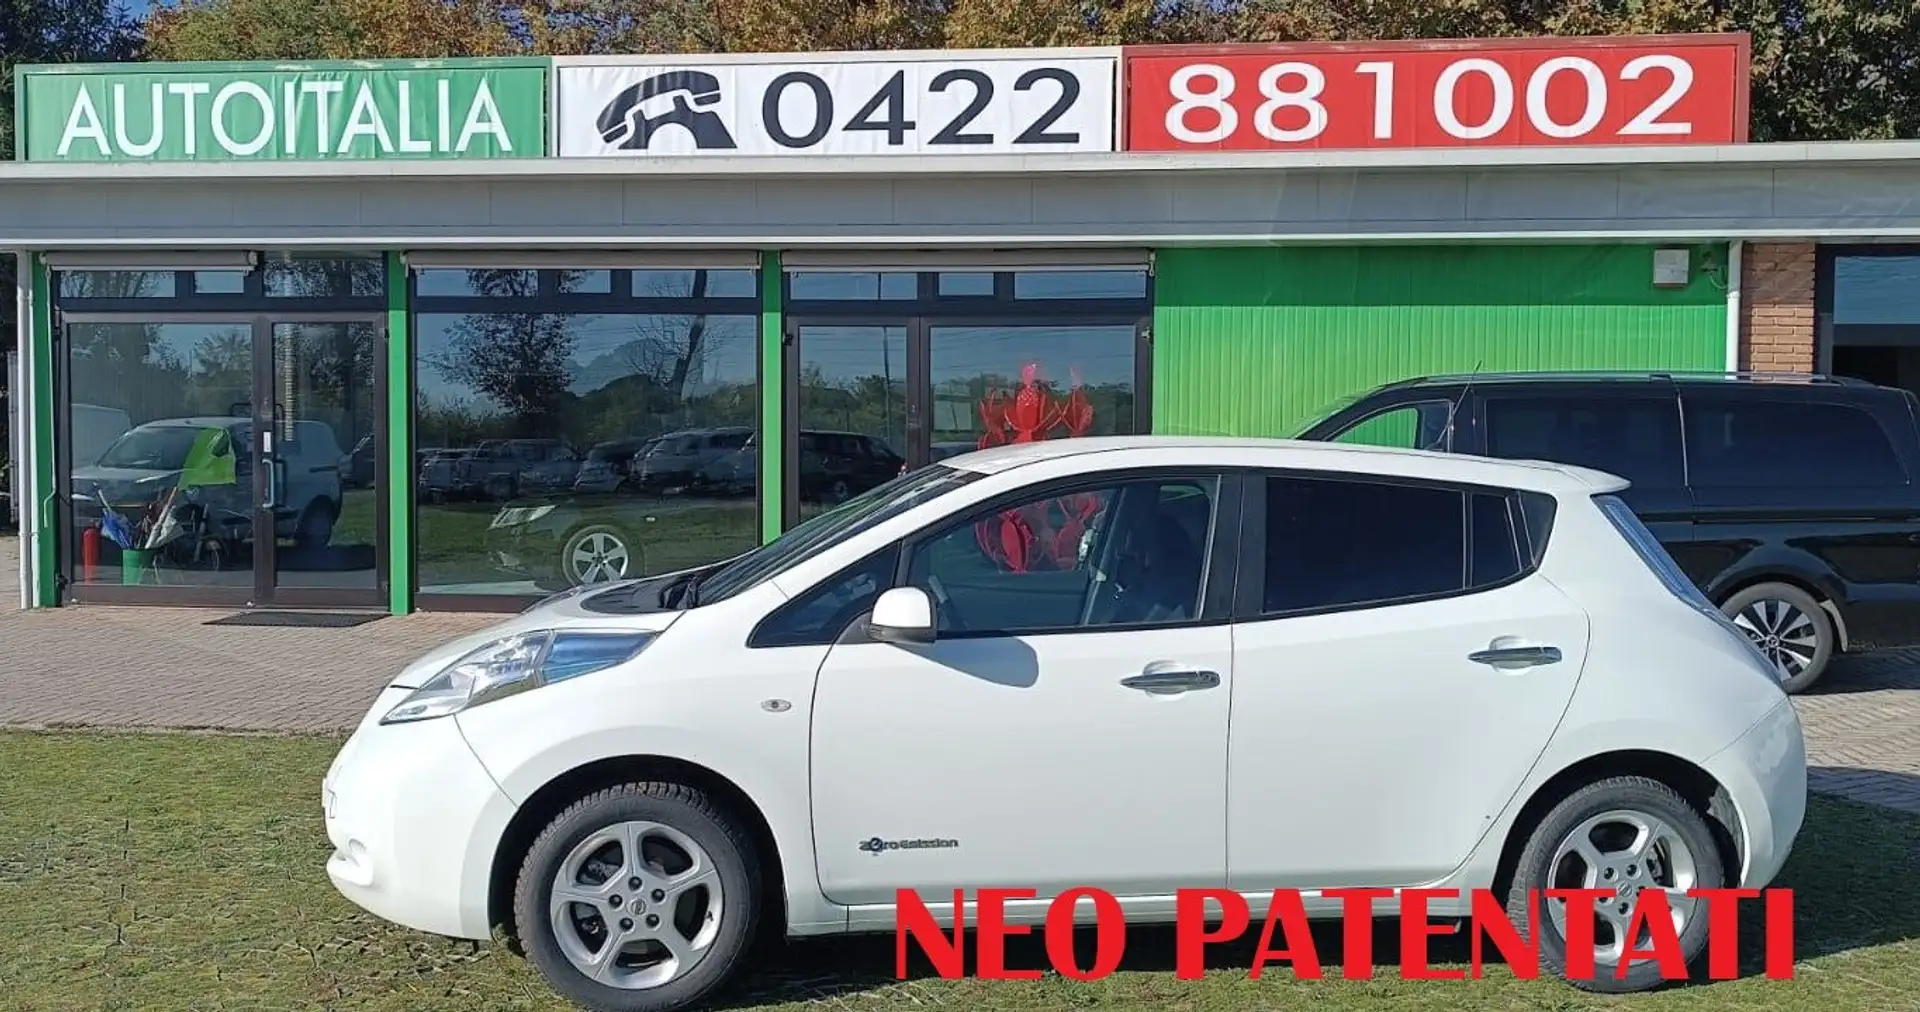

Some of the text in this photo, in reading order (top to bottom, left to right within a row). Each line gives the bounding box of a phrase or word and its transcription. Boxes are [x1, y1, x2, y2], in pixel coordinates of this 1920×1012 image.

[58, 78, 513, 157] AUTOITALIA
[761, 67, 1081, 148] 0422
[1163, 54, 1695, 144] 881002
